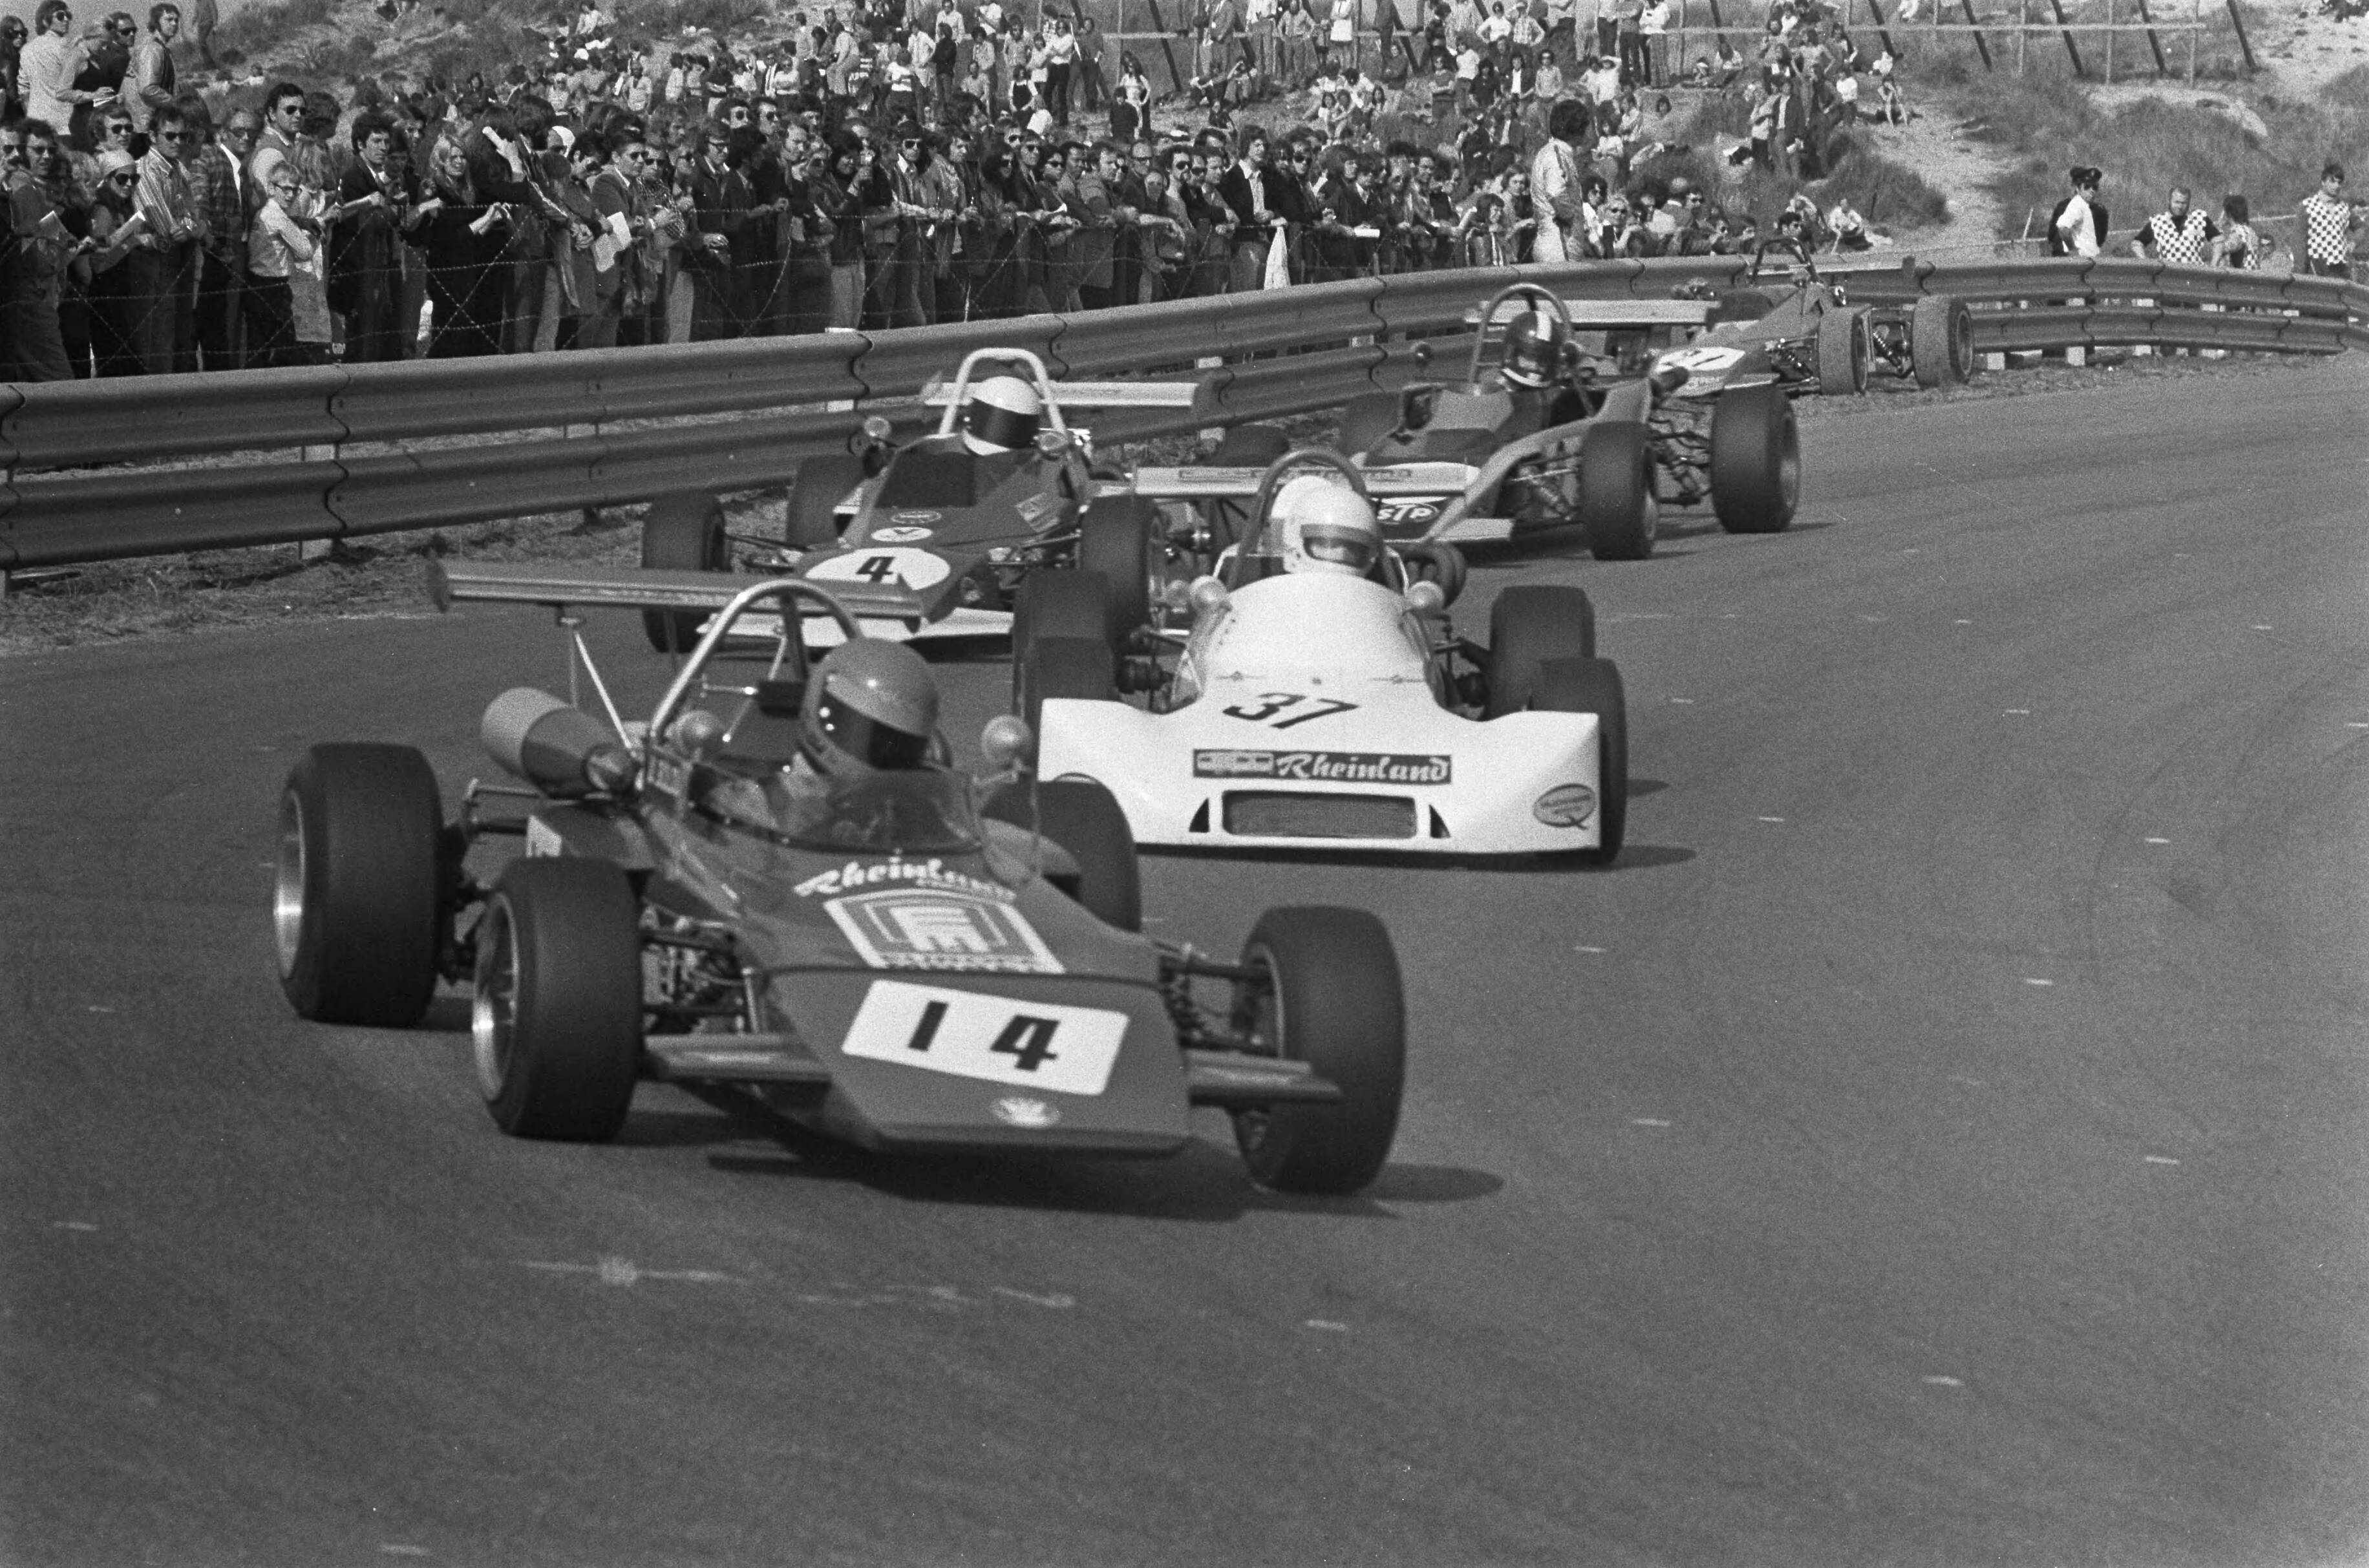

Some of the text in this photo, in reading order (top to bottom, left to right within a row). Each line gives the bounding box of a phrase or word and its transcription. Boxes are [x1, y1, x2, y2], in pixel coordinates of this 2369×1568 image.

[1376, 503, 1434, 522] STP
[855, 556, 896, 582] 4
[1222, 692, 1360, 729] 37
[1274, 752, 1449, 782] Rheinland
[908, 1001, 1061, 1072] 14
